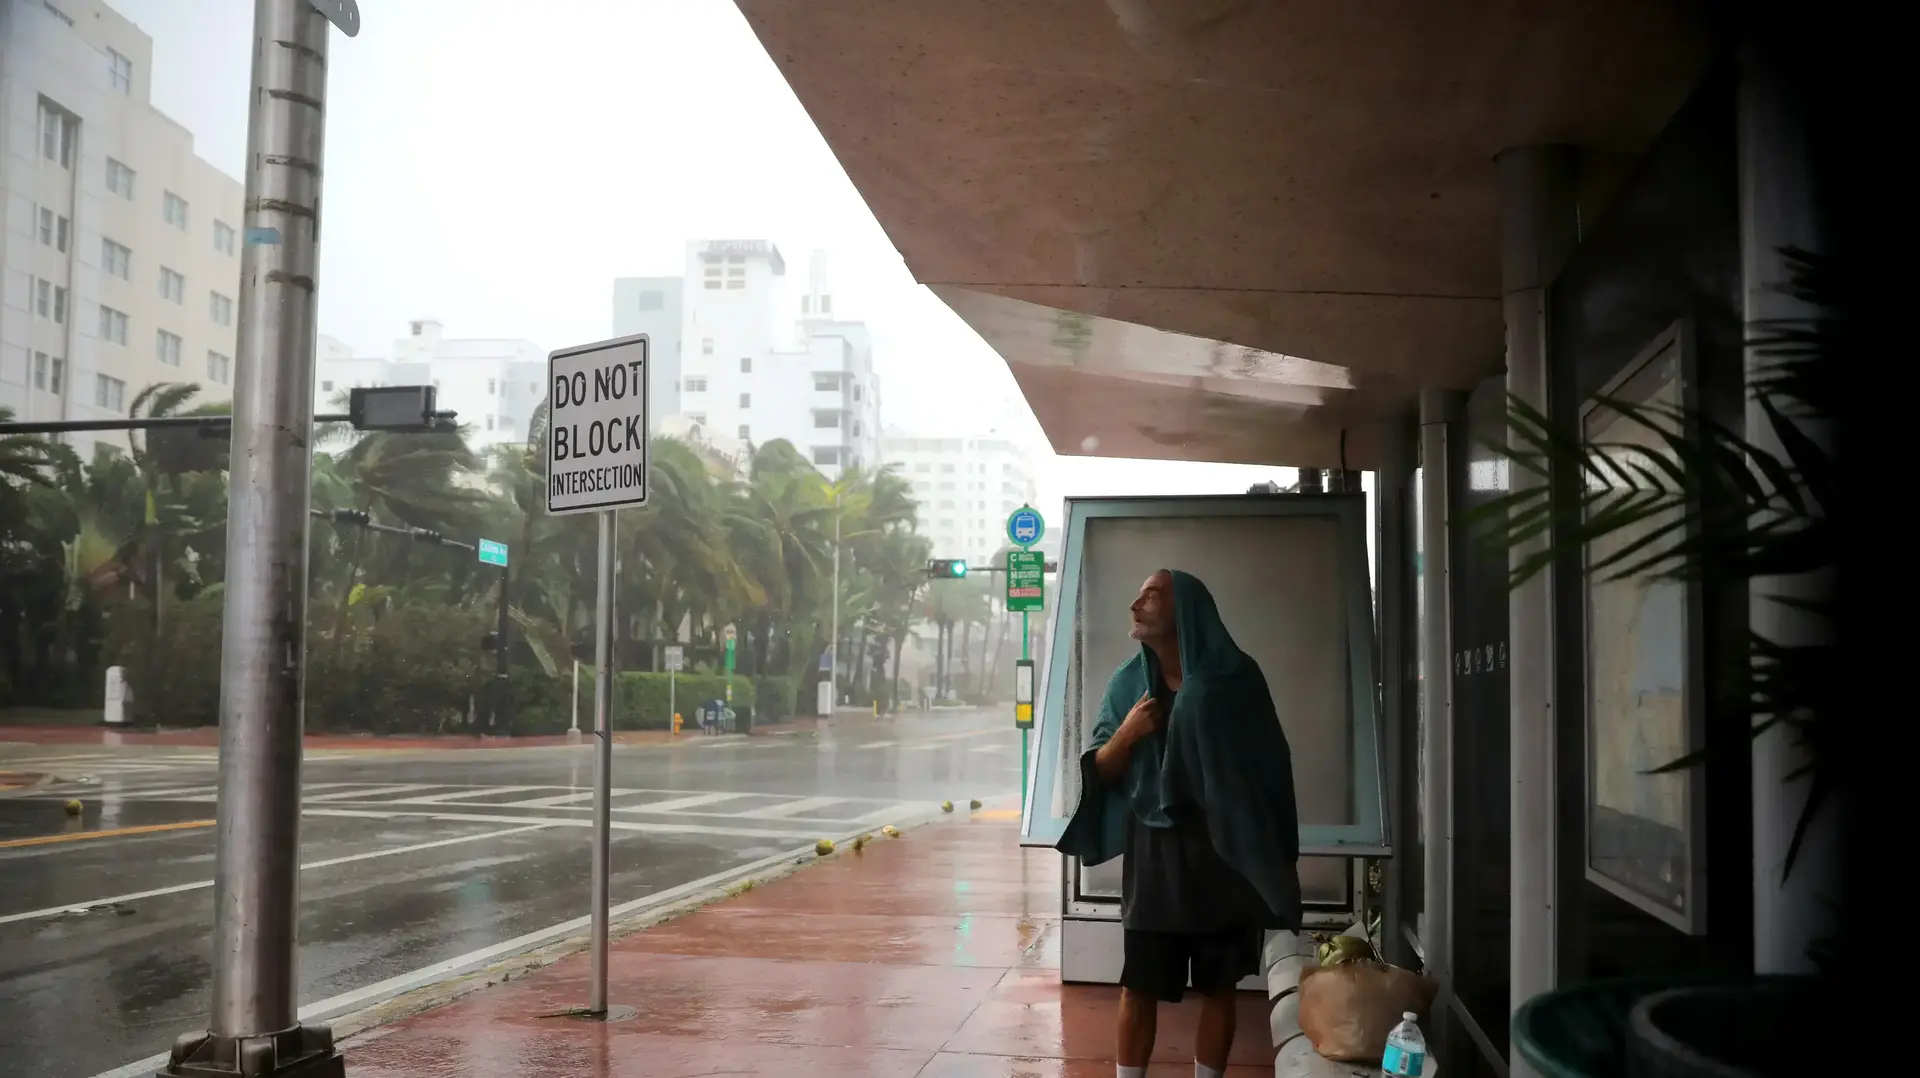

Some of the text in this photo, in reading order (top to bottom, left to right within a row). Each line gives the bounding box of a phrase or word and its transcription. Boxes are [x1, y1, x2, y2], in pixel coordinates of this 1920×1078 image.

[555, 360, 642, 409] DO NOT
[554, 414, 641, 461] BLOCK
[552, 463, 642, 496] INTERSECTION
[1010, 553, 1017, 561] C
[1010, 562, 1017, 571] L
[1010, 579, 1017, 588] S
